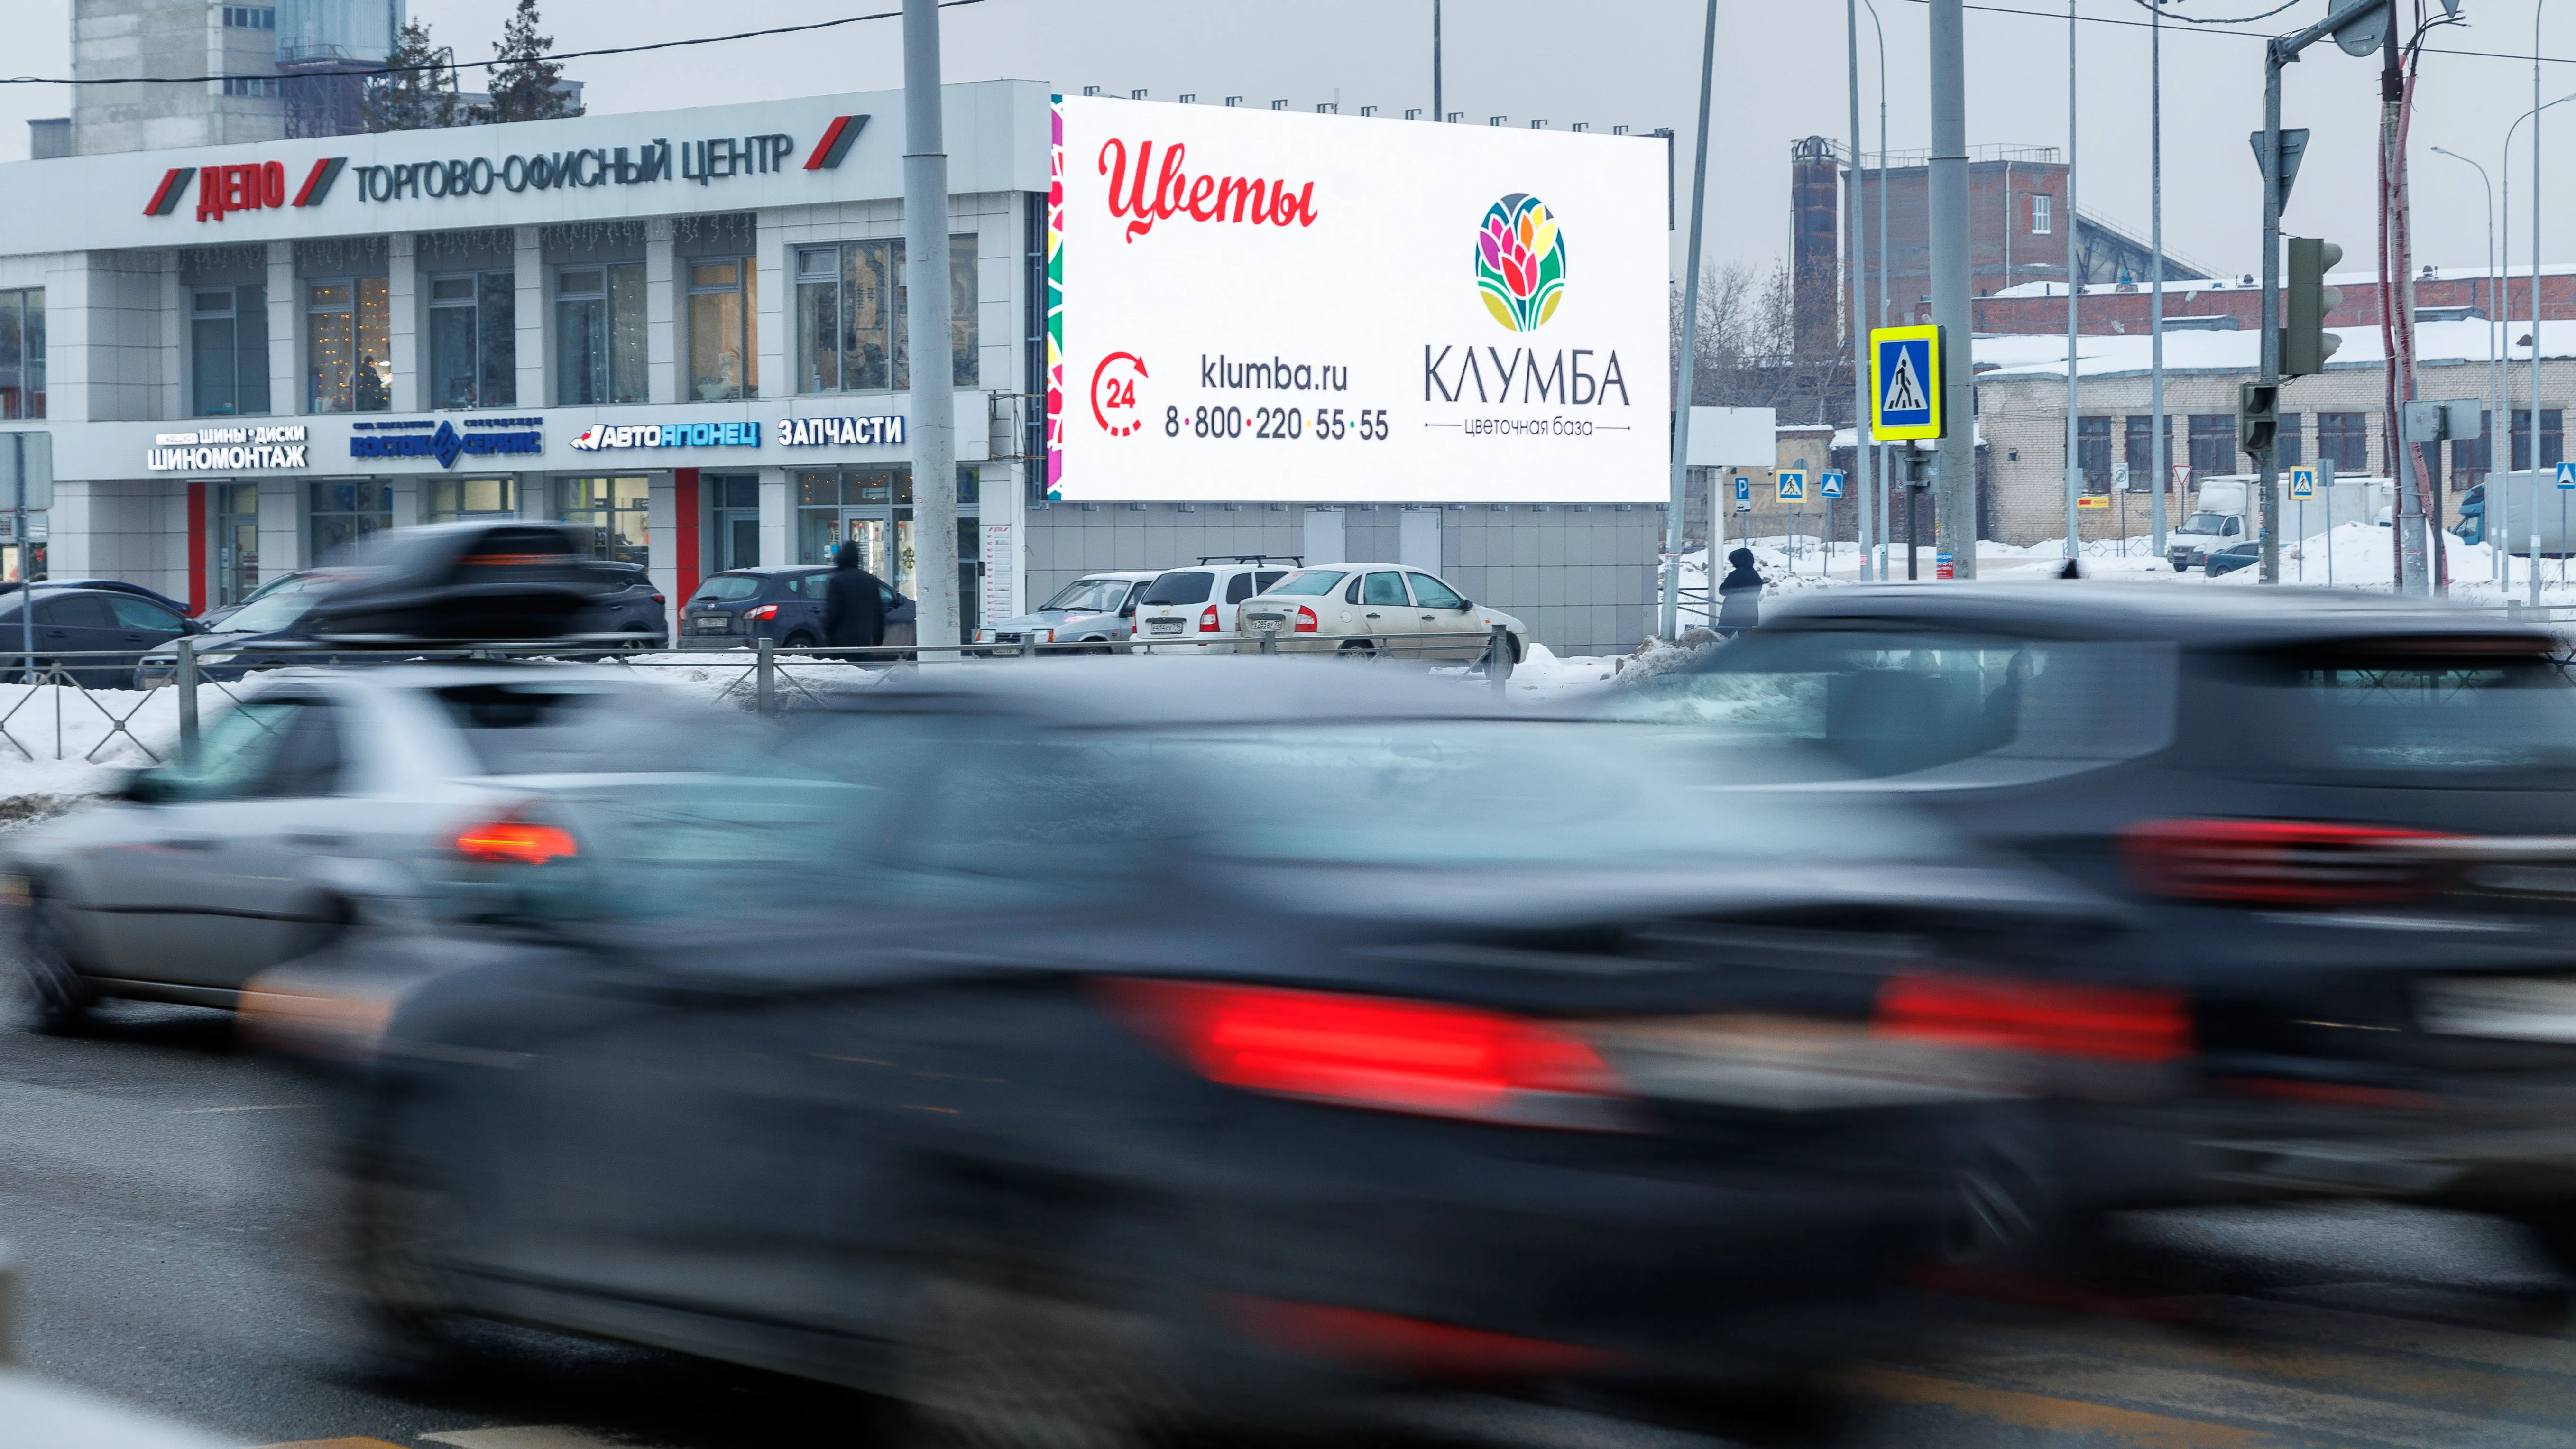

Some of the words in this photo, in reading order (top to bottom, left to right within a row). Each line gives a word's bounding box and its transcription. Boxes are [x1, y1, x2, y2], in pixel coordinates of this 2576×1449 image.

[352, 138, 671, 203] ТОРГОВО-ОФИСНЫЙ
[682, 133, 793, 187] ЦЕНТР
[197, 160, 285, 222] ДЕПО
[1098, 138, 1318, 244] Цветы
[1202, 354, 1347, 392] klumba.ru
[1425, 344, 1630, 406] КЛУМБА
[1106, 378, 1136, 409] 24
[199, 428, 247, 444] ШИНЫ
[255, 425, 306, 444] ДИСКИ
[599, 421, 759, 448] АВТОЯПОНЕЦ
[778, 415, 904, 446] ЗАПЧАСТИ
[1464, 418, 1548, 437] цветочная
[1552, 416, 1592, 436] база
[147, 445, 306, 471] ШИНОМОНТАЖ
[350, 434, 432, 457] ВОСТОК
[461, 431, 542, 453] СЕРВИС
